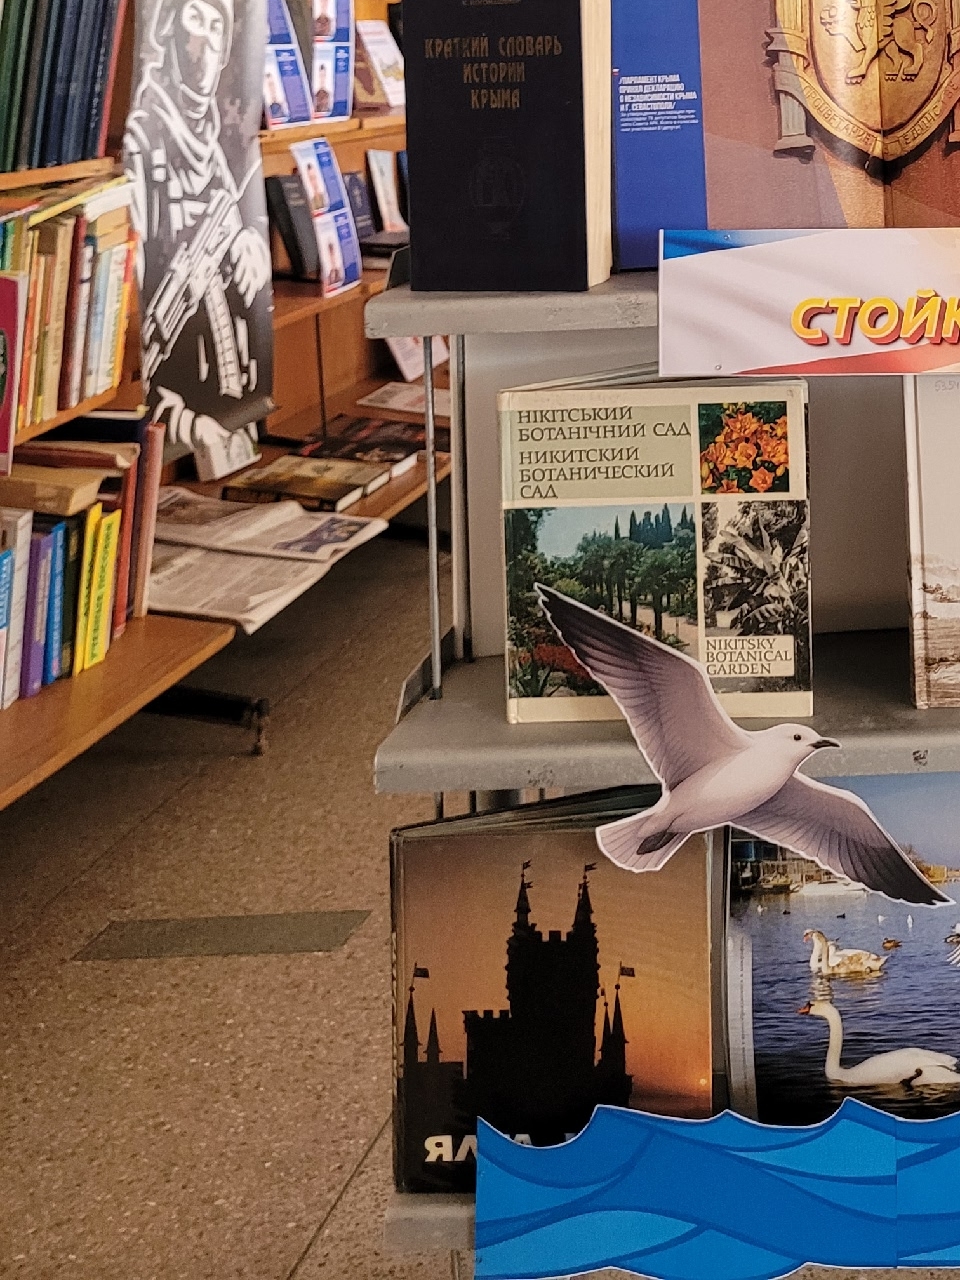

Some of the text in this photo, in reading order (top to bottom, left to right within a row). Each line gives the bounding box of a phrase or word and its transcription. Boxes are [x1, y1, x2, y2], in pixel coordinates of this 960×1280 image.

[424, 33, 563, 59] КРАТКИЙ СЛОВАРЬ
[463, 61, 526, 84] ИСТОРИИ
[471, 88, 520, 109] КРЫМА
[517, 405, 633, 424] НІКІТСЬКИЙ
[518, 422, 692, 441] БОТАНІЧНИЙ САД
[519, 446, 640, 464] НИКИТСКИЙ
[519, 464, 675, 483] БОТАНИЧЕСКИЙ
[520, 485, 559, 500] САД
[706, 638, 776, 651] NIKITSKY
[706, 649, 793, 663] BOTANICAL
[706, 662, 772, 675] GARDEN
